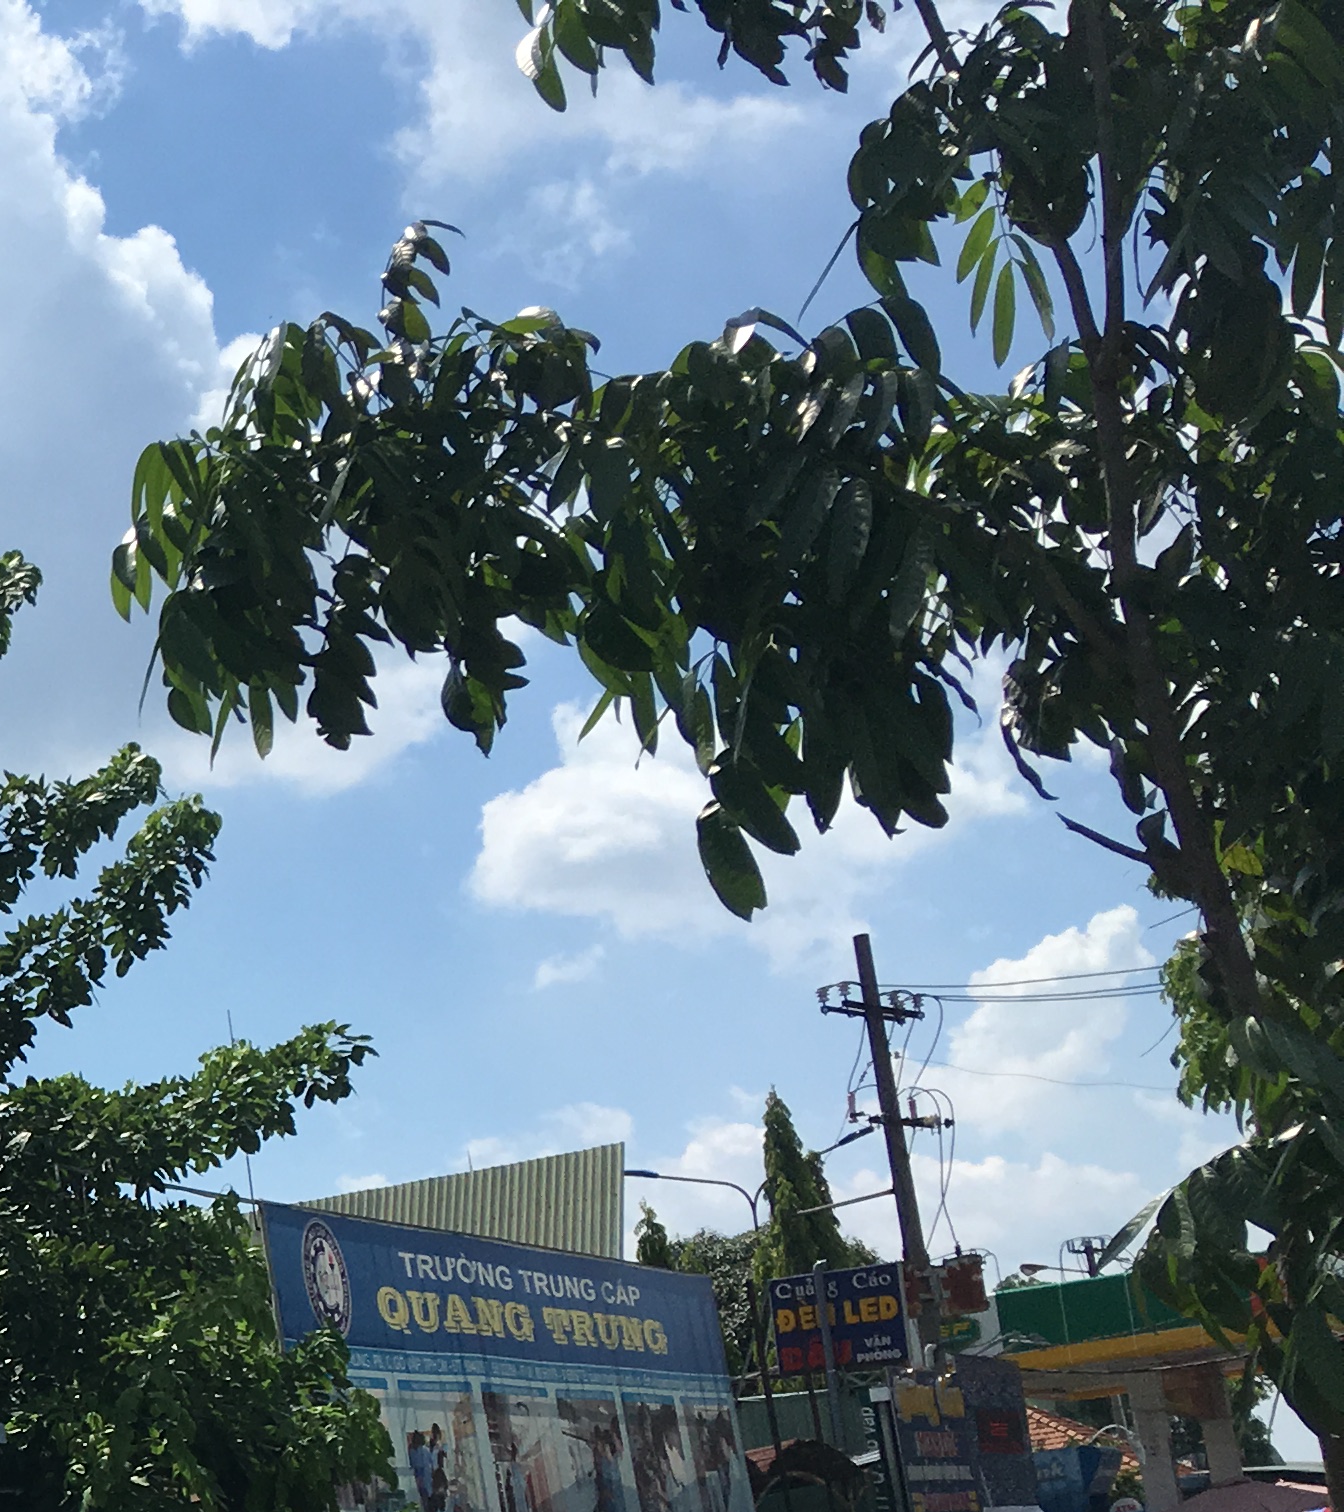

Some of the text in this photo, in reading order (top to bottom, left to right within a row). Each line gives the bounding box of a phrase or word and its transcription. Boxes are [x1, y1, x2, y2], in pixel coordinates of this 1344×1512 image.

[398, 1251, 514, 1291] TRƯỜNG
[518, 1269, 597, 1302] TRUNG
[852, 1271, 892, 1289] Cáo
[376, 1286, 669, 1355] QUANG TRUNG
[843, 1295, 898, 1324] LED
